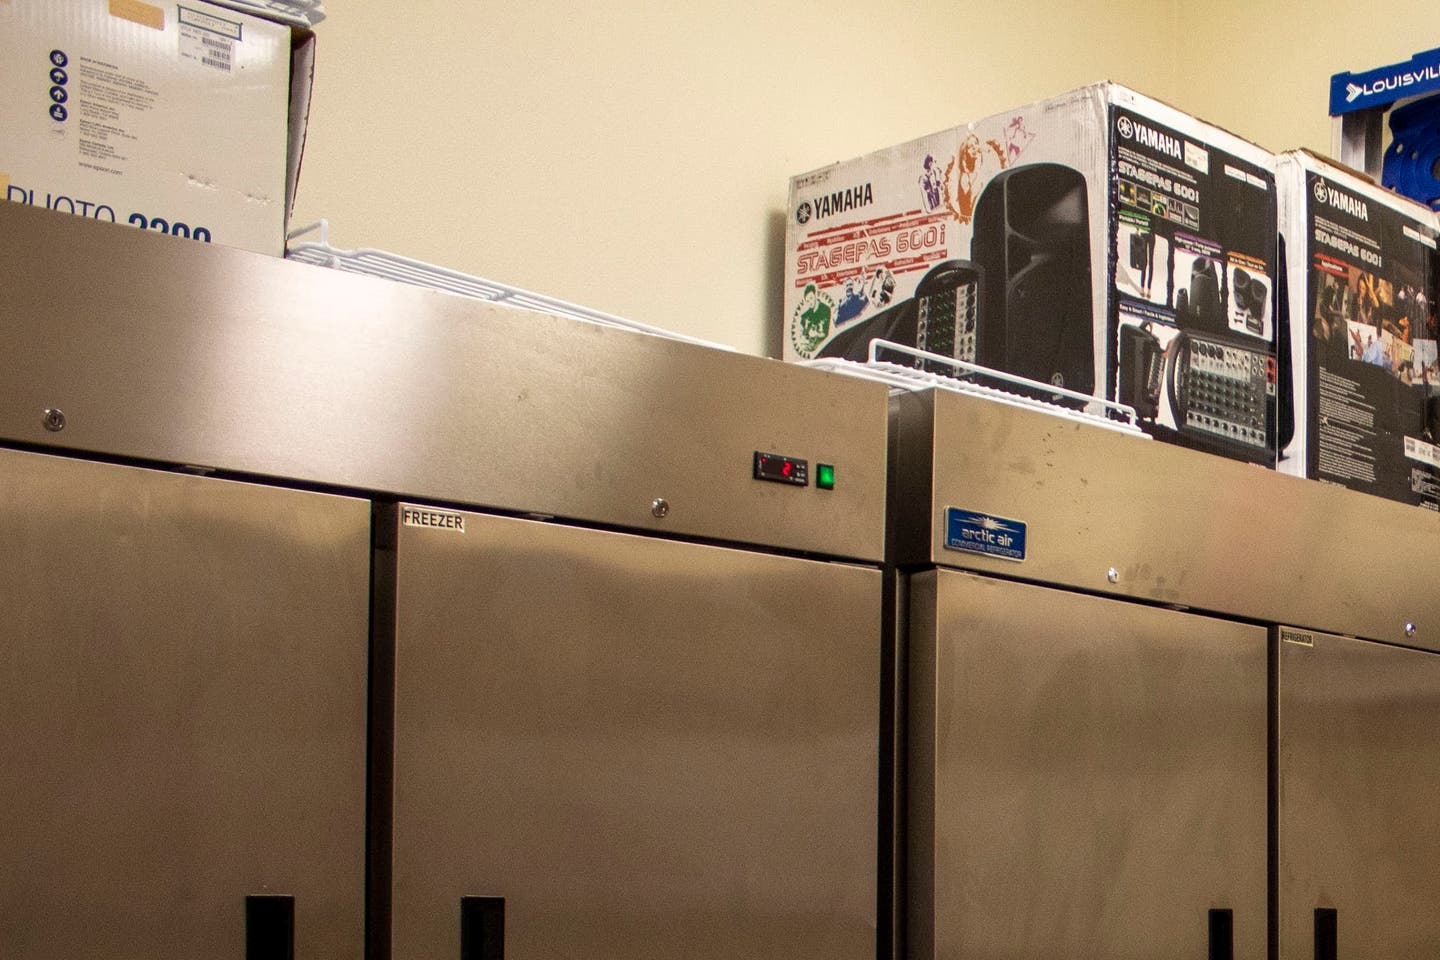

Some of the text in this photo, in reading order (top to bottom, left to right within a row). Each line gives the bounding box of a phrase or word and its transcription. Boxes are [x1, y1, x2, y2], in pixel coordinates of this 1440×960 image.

[1133, 121, 1182, 160] YAMAHA
[1118, 160, 1172, 192] STAGEPAS
[813, 182, 874, 219] YAMAHA
[1327, 187, 1368, 222] YAMAHA
[797, 237, 891, 275] STAGEPAS
[1315, 229, 1359, 258] STAGEPAS
[404, 510, 463, 529] FREEZER
[961, 528, 1013, 547] arctic air
